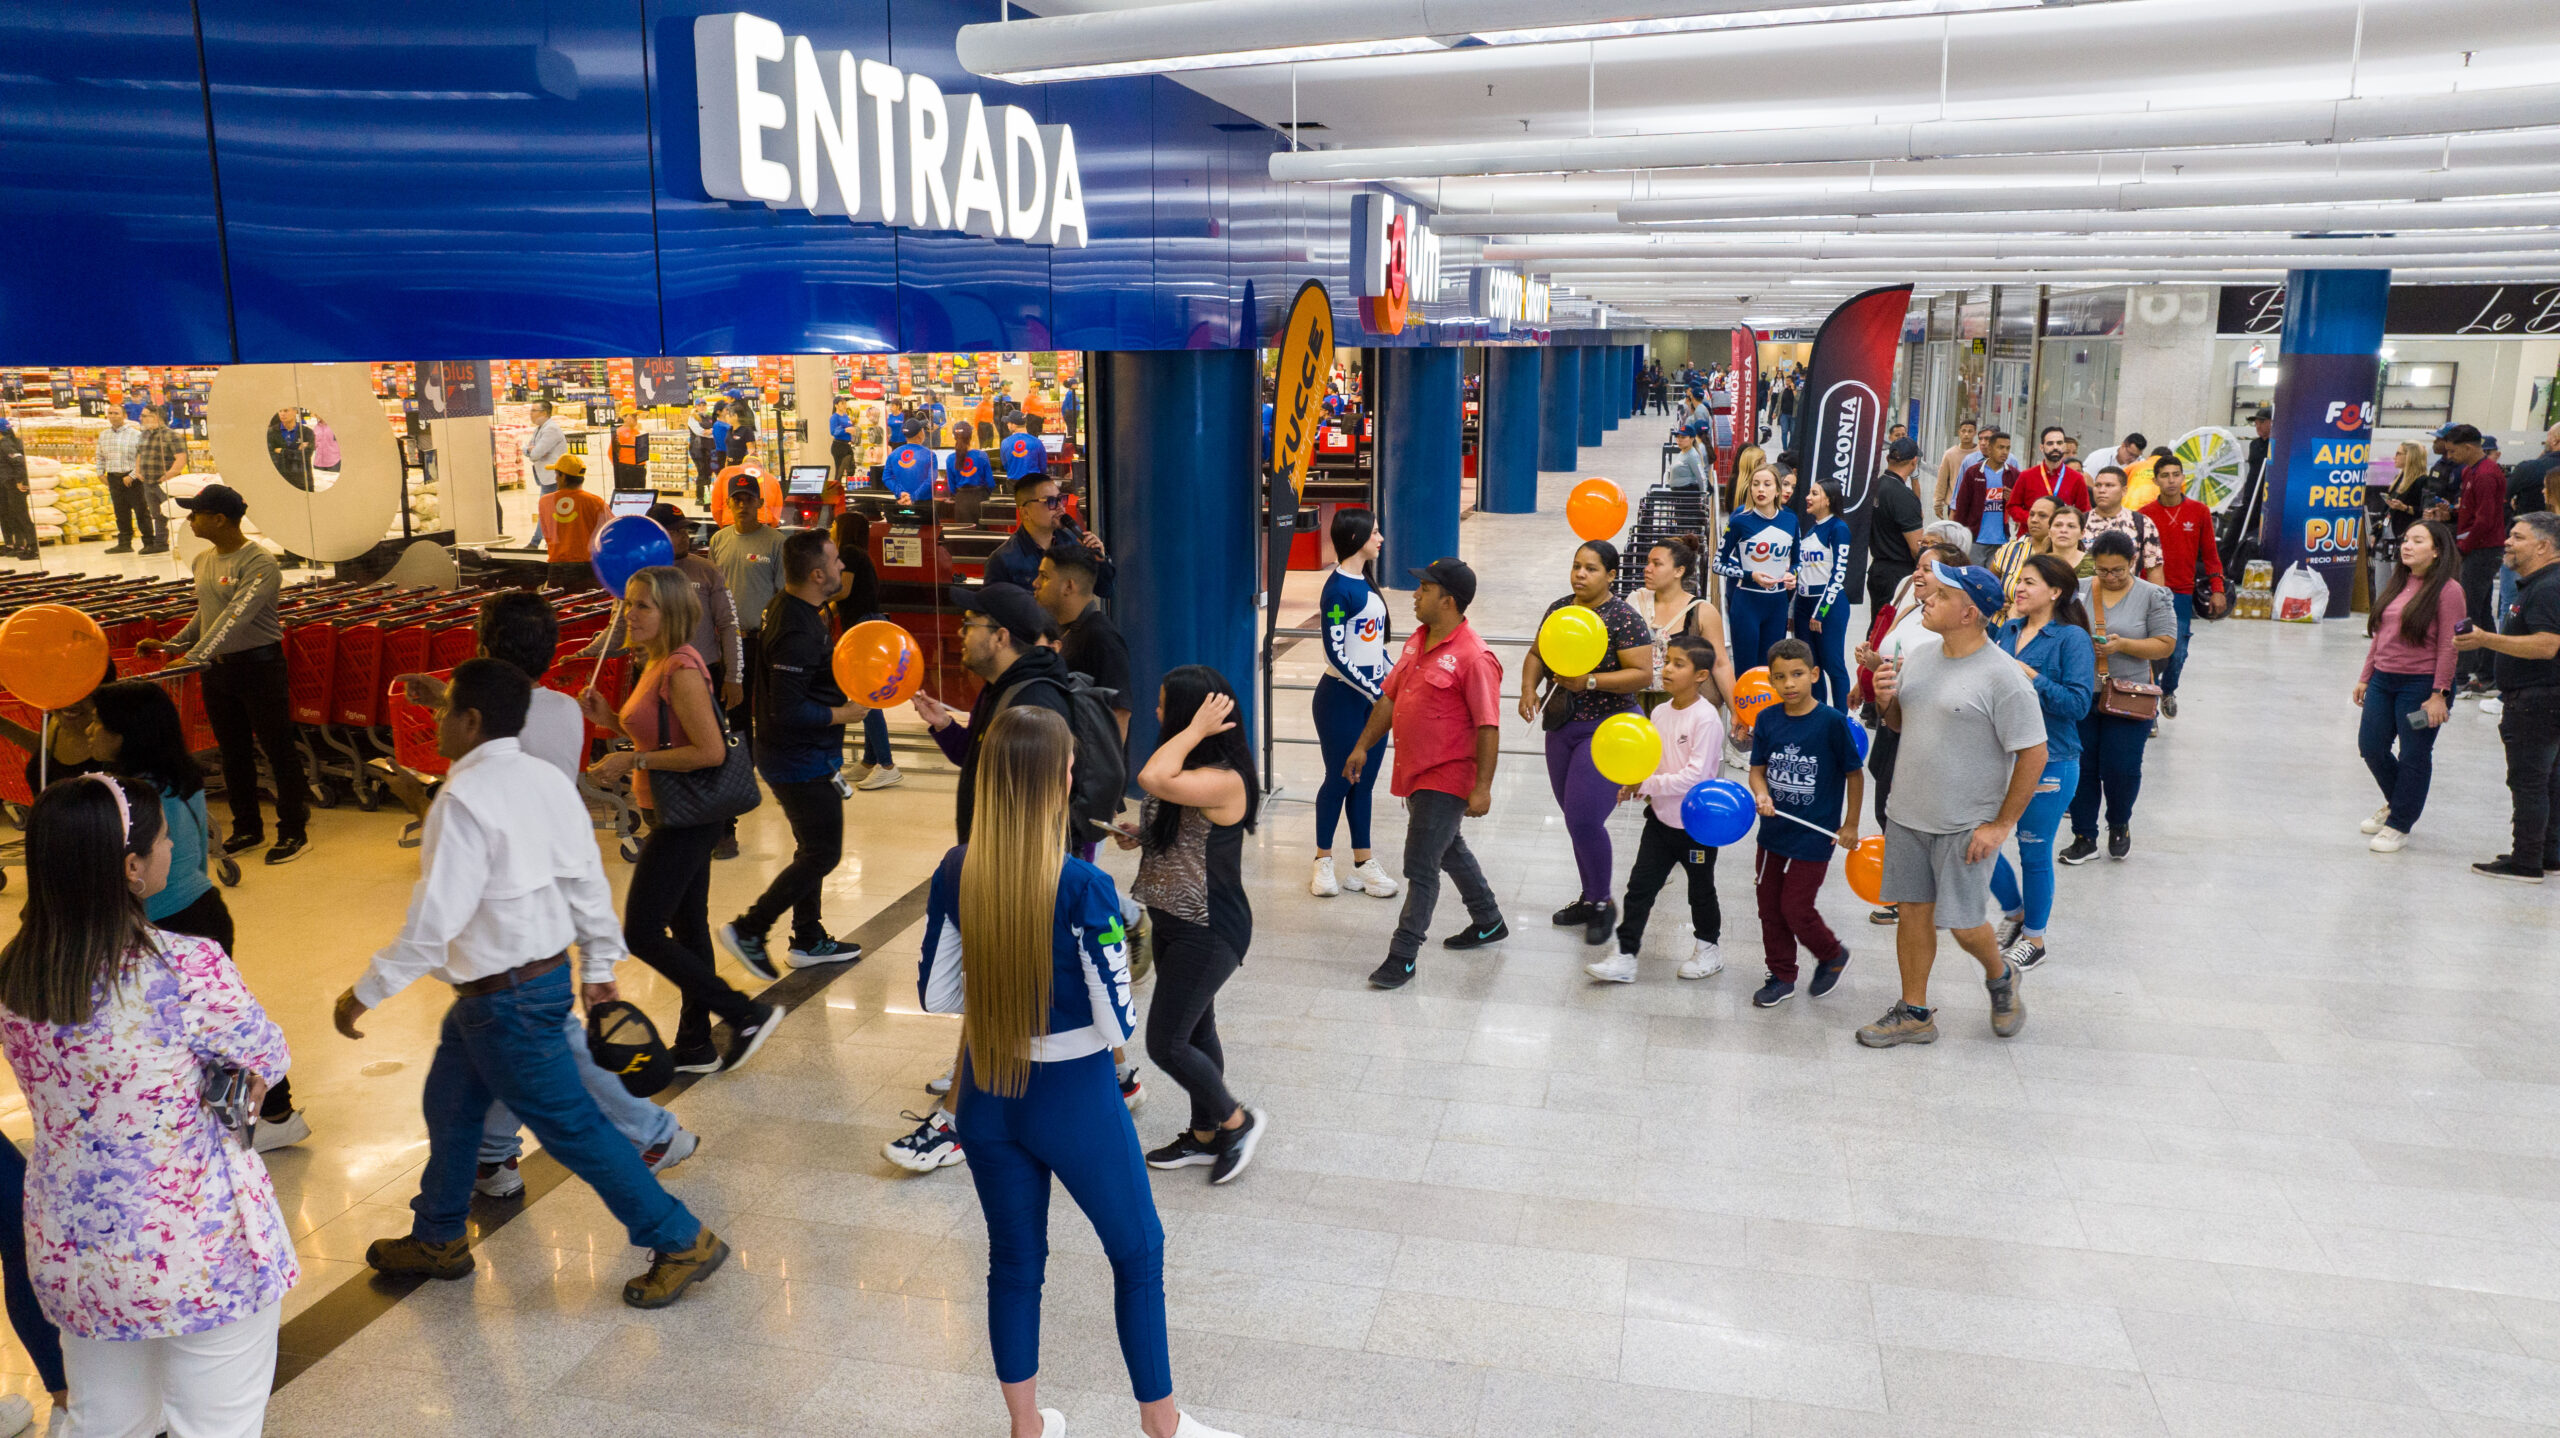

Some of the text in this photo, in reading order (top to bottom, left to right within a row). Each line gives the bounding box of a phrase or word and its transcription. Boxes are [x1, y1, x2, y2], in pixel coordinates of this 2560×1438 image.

[734, 12, 1088, 248] ENTRADA
[2456, 286, 2516, 334] Le
[443, 360, 475, 382] plus
[651, 359, 675, 376] plus
[2329, 470, 2361, 484] CON
[1826, 544, 1850, 605] ahorra
[199, 617, 236, 660] compra
[1770, 751, 1818, 764] ADIDAS
[1766, 768, 1817, 786] NALS
